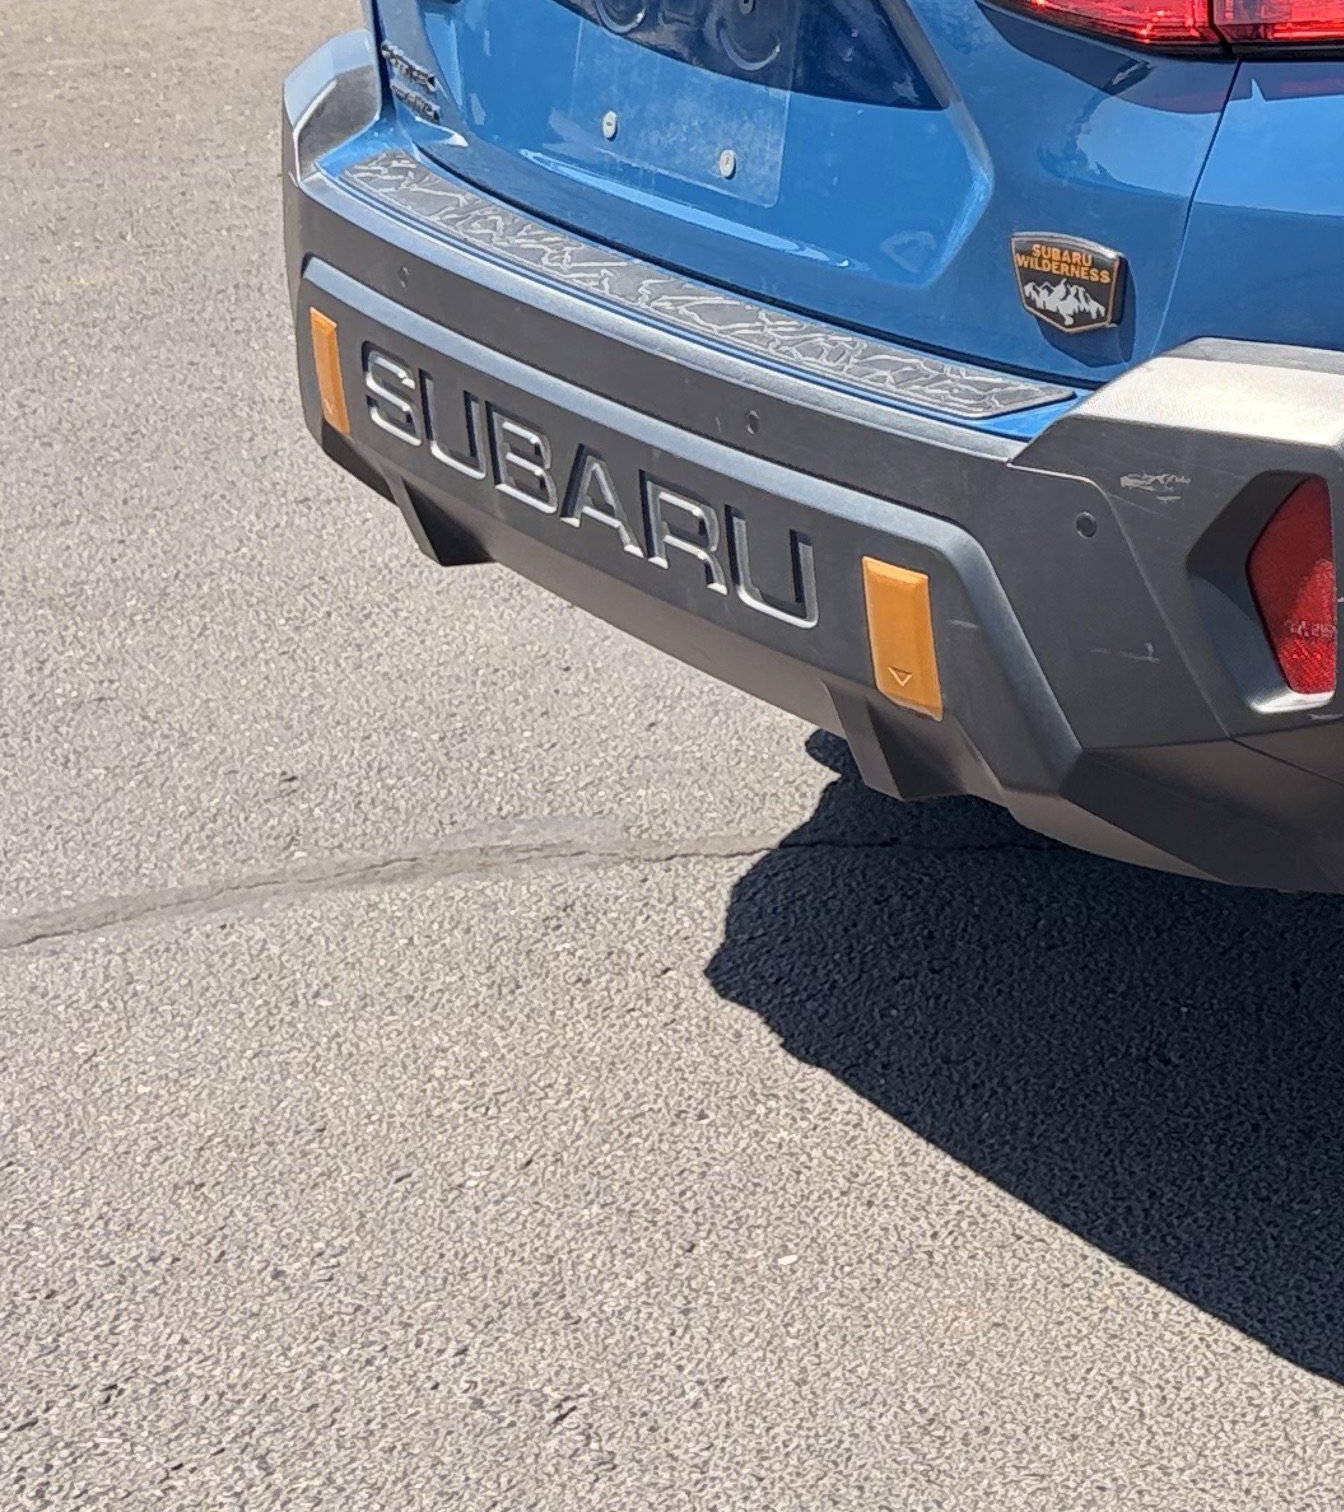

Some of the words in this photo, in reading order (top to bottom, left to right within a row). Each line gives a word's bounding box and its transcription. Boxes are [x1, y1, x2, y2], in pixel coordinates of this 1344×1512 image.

[1016, 253, 1111, 284] WILDERNESS
[1031, 243, 1093, 267] SUBARU
[362, 341, 819, 629] SUBARU
